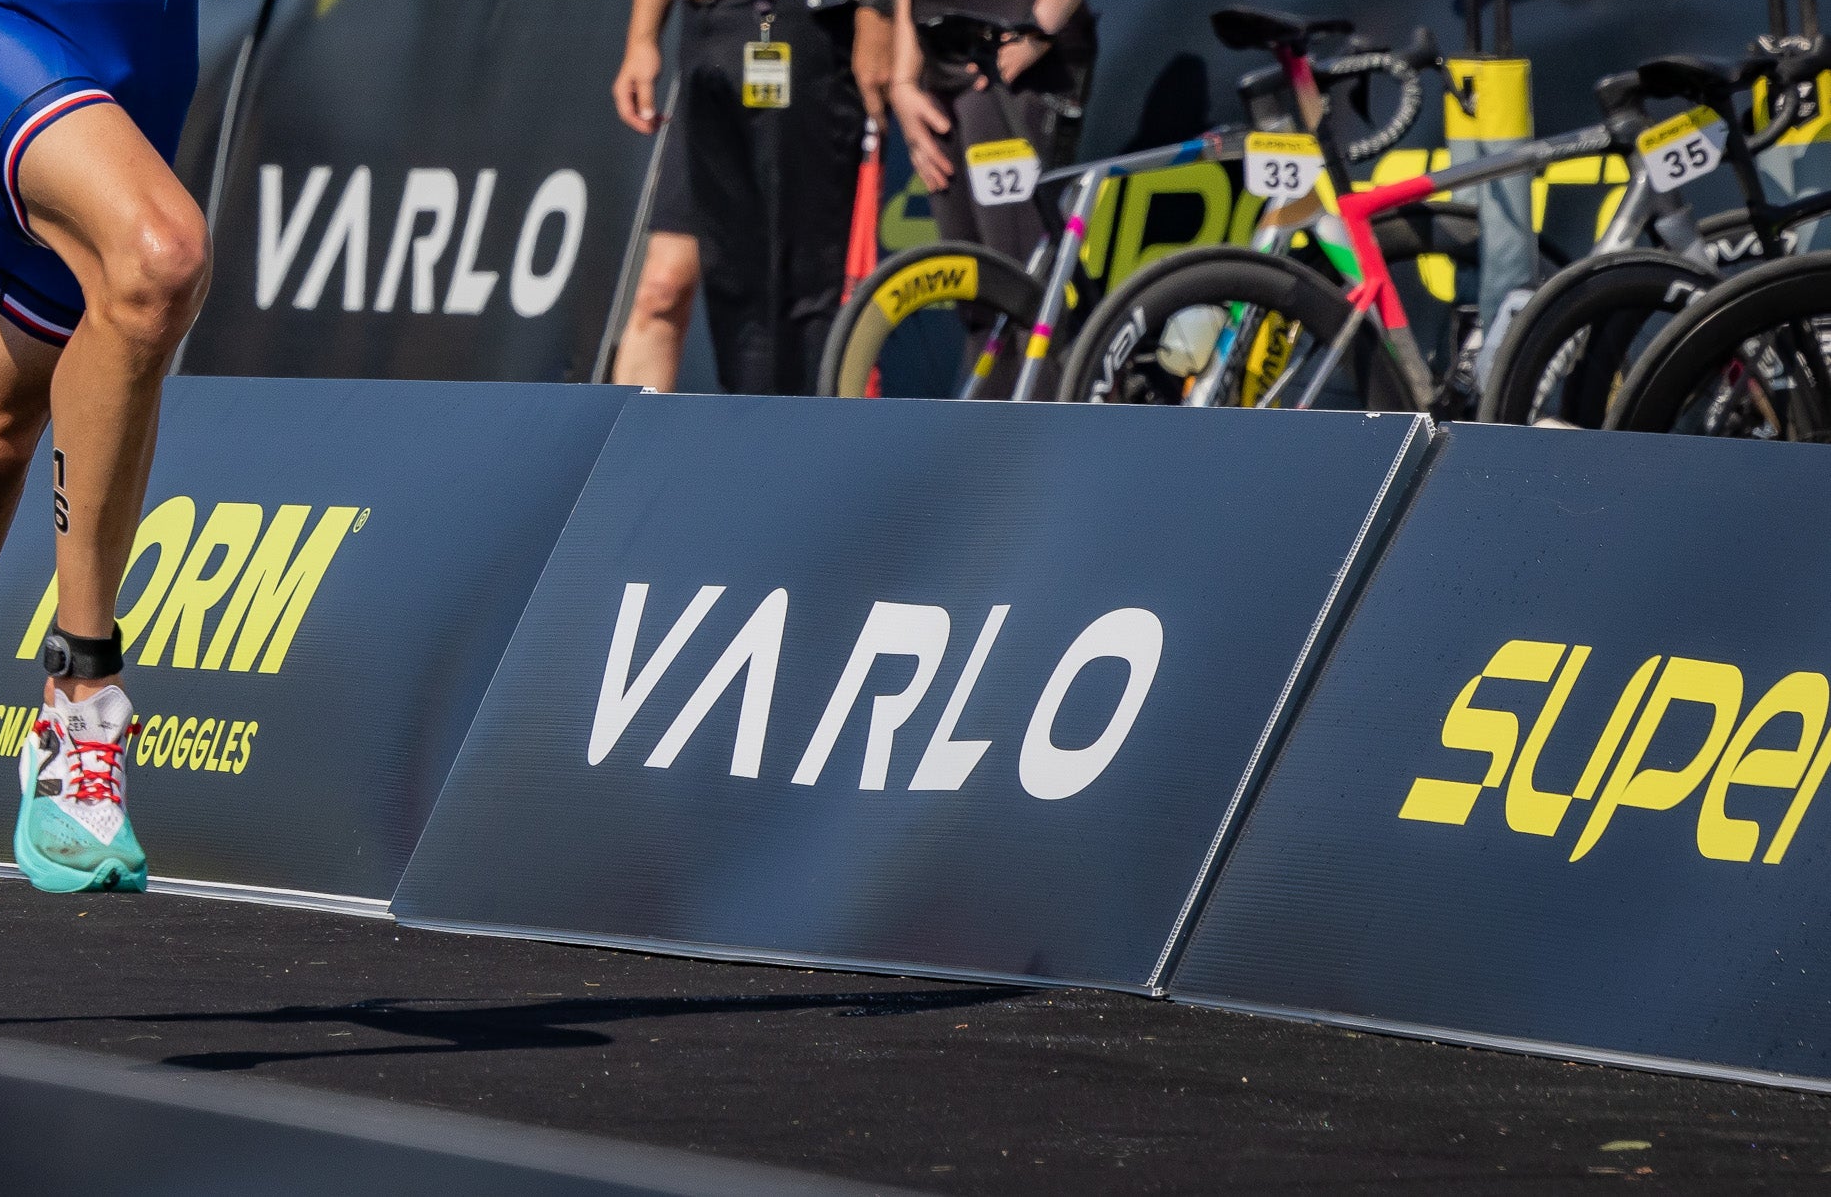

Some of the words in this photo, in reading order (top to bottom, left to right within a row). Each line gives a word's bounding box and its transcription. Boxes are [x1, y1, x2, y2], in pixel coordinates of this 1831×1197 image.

[986, 168, 1024, 196] 32
[1263, 161, 1300, 190] 33
[1662, 138, 1709, 179] 35
[255, 163, 589, 319] VARLO
[587, 581, 1164, 801] VARLO
[135, 713, 259, 775] GOGGLES
